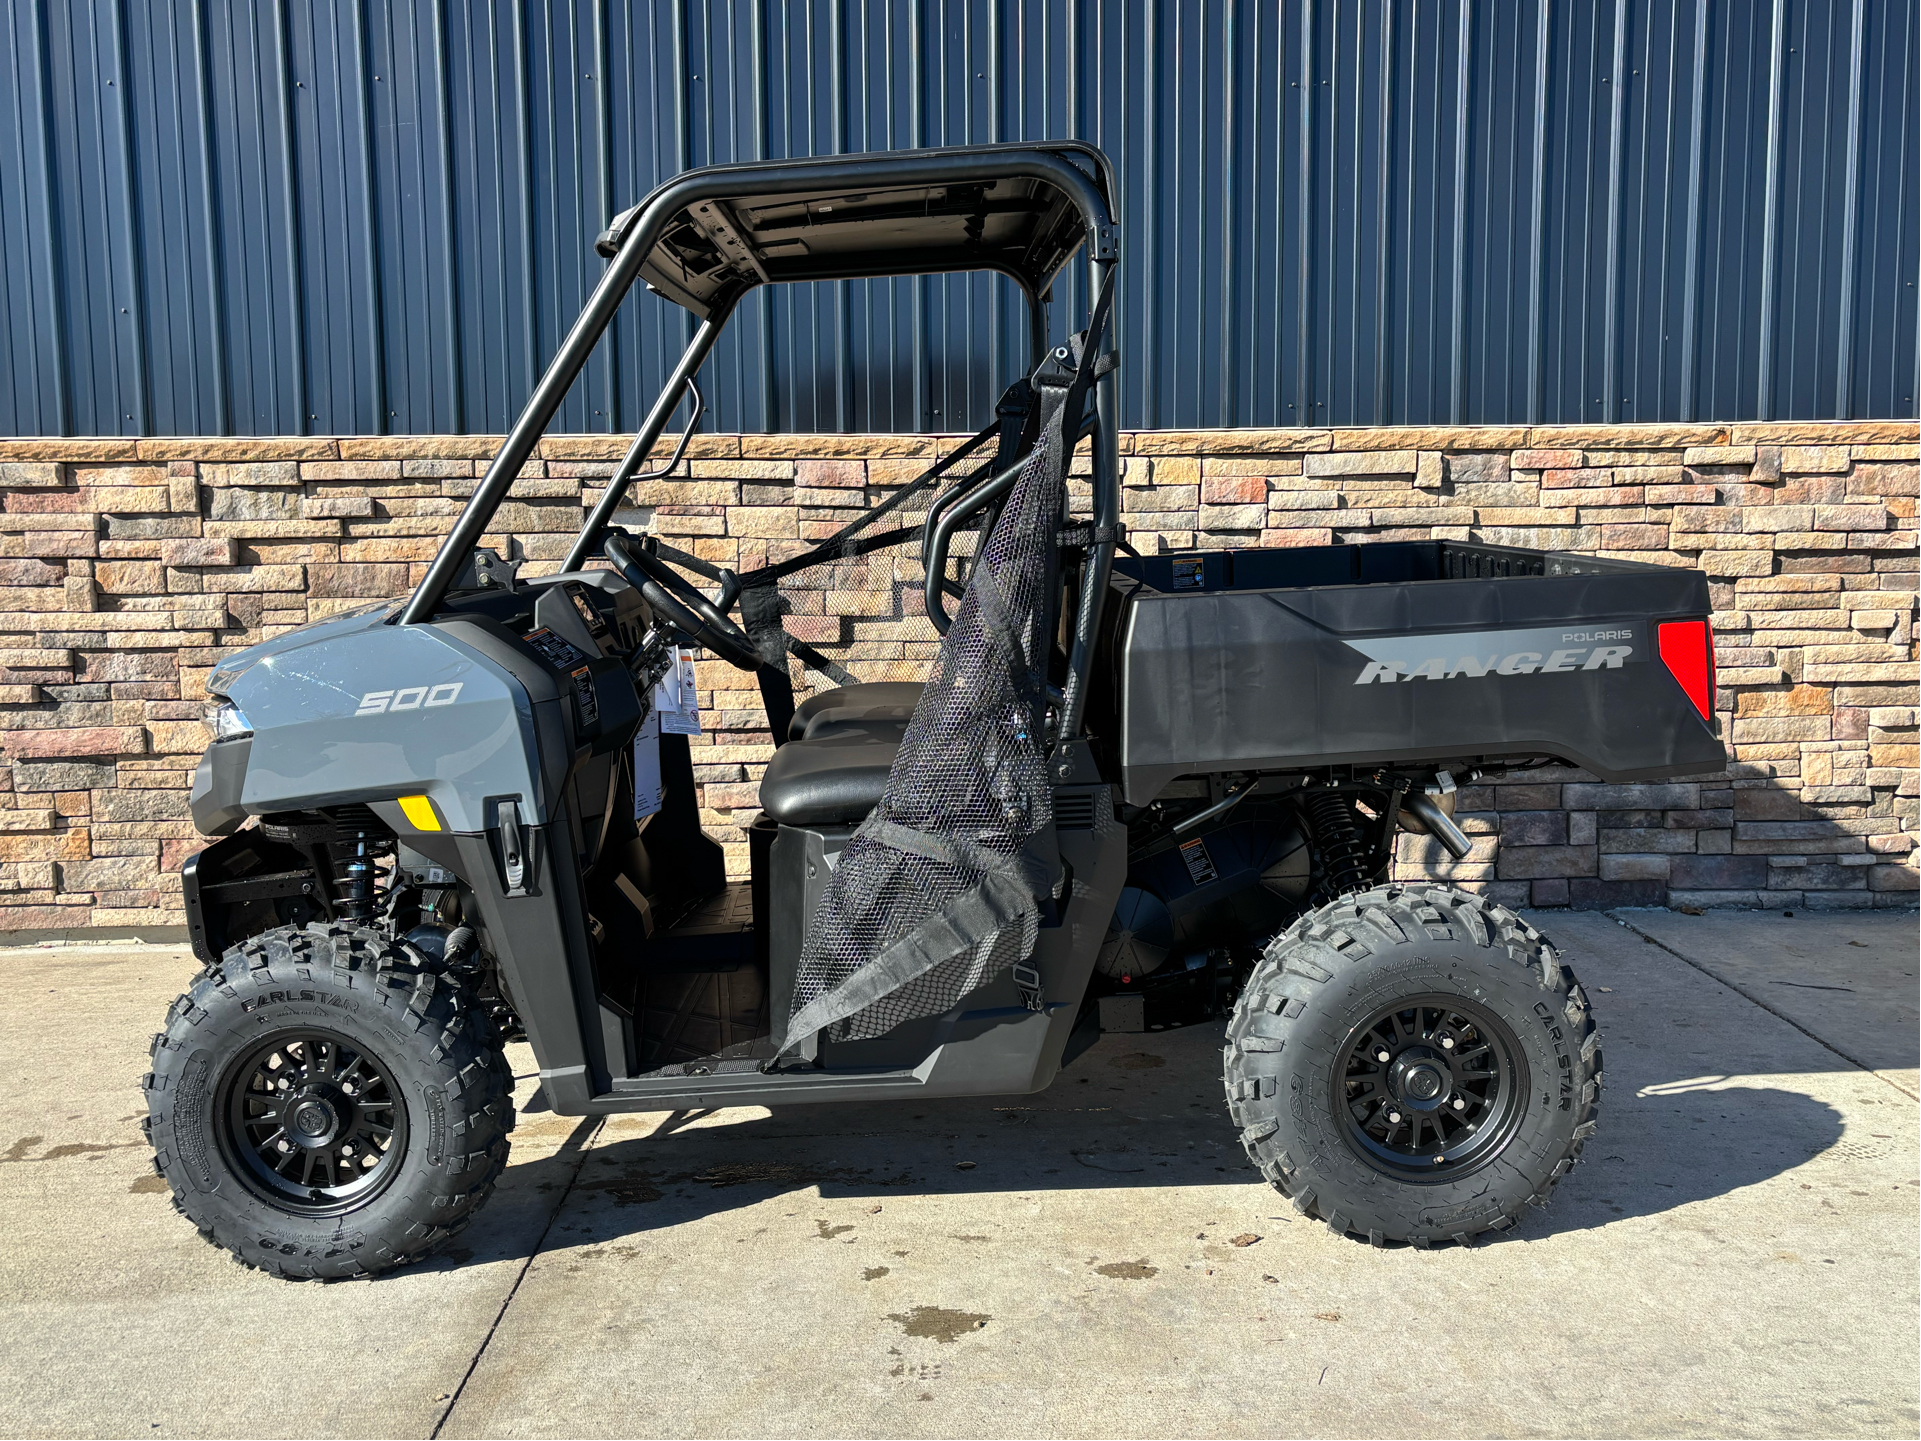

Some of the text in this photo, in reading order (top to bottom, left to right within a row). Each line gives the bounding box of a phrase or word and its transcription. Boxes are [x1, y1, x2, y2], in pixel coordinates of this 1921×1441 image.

[1562, 629, 1633, 643] POLARIS
[1353, 645, 1634, 686] RANGER
[355, 682, 464, 717] 500
[240, 989, 360, 1014] CARLSTAR
[1532, 1001, 1574, 1112] CARLSTAR
